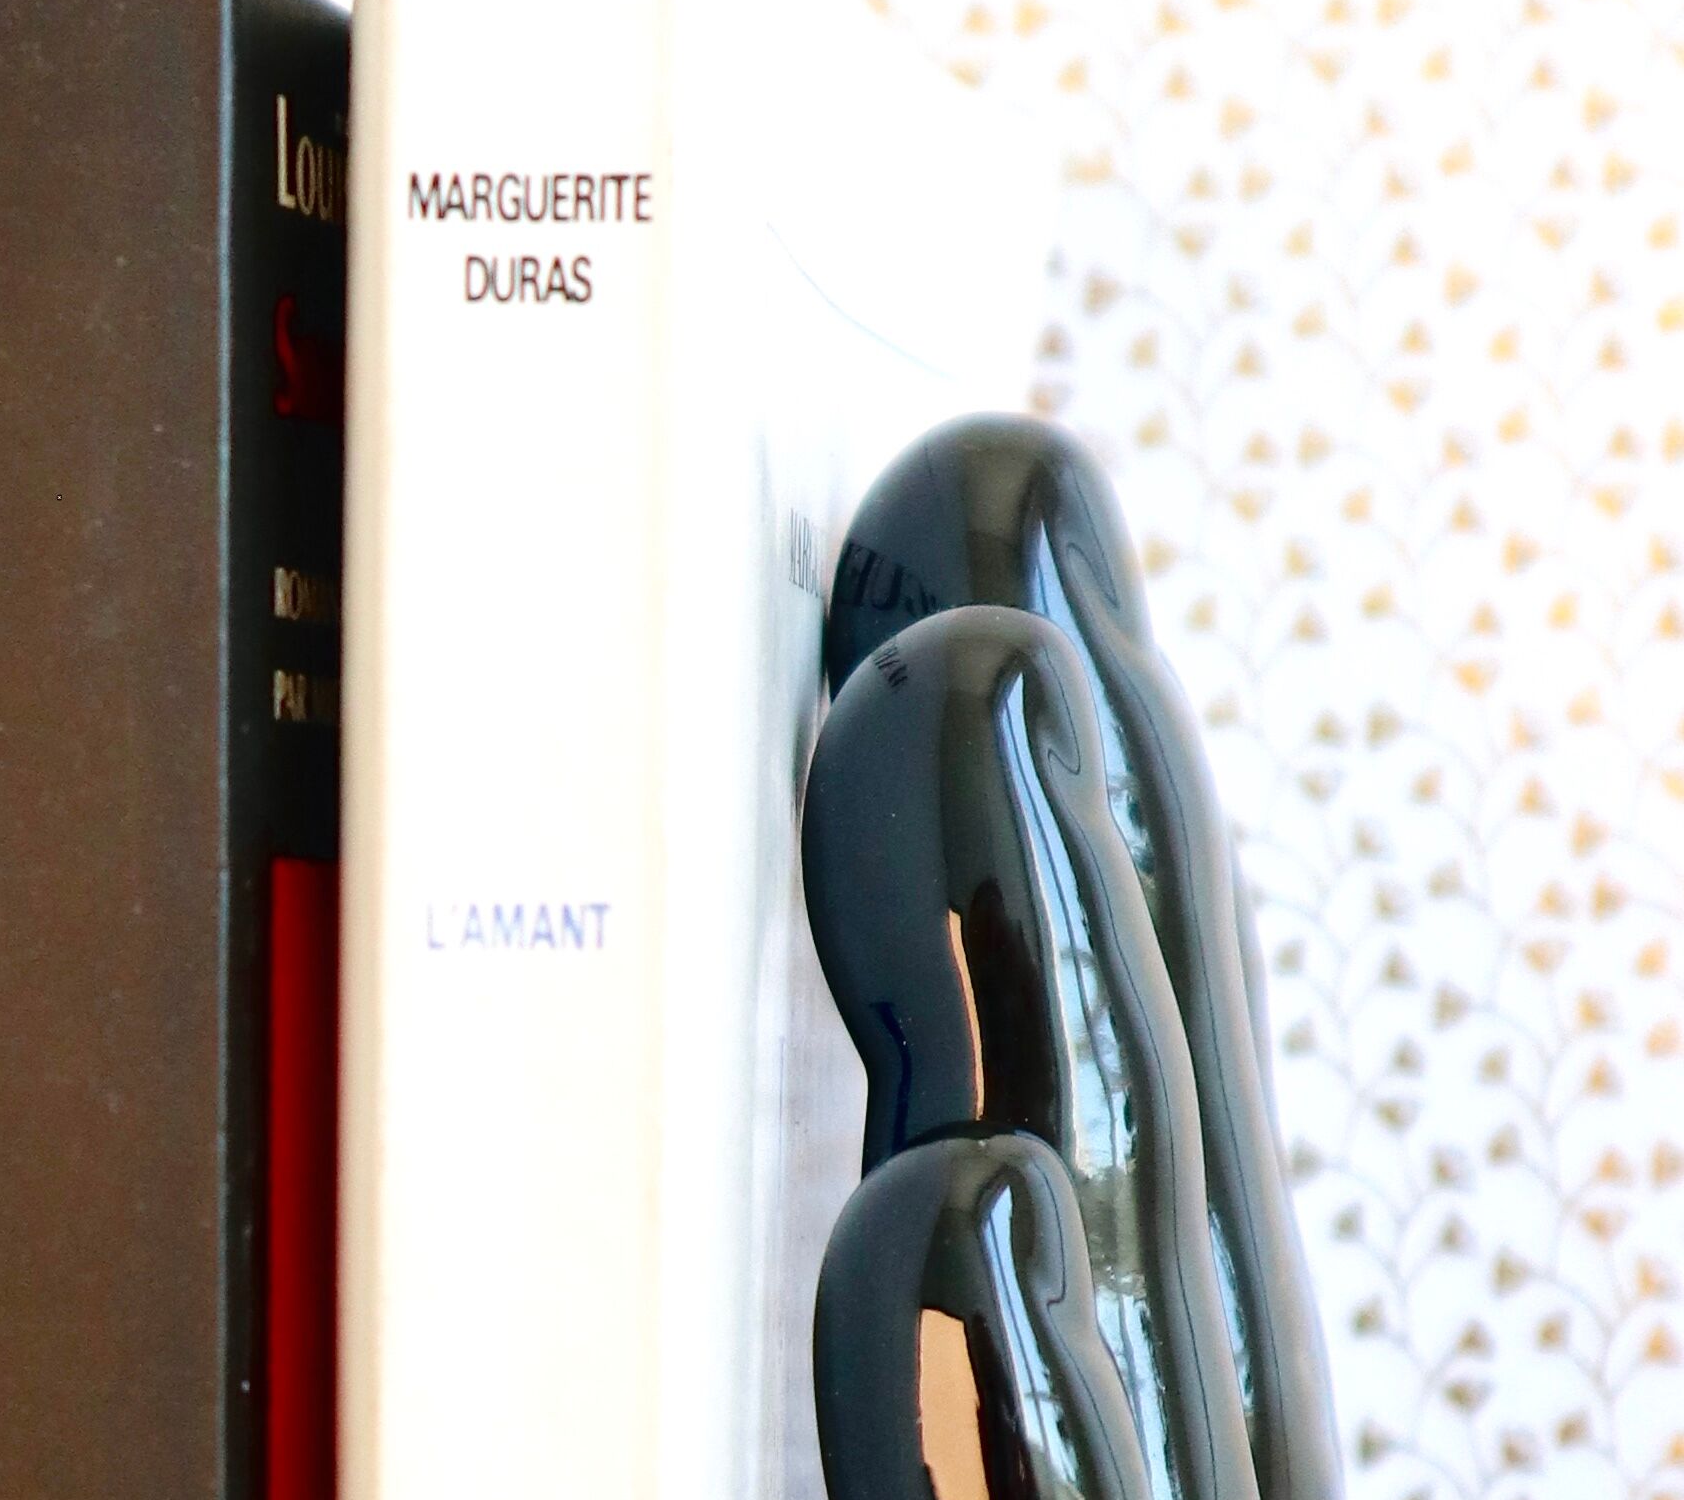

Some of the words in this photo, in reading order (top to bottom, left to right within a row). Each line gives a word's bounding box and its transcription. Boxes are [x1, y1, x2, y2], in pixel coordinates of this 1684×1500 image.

[408, 172, 652, 223] MARGUERITE
[464, 255, 593, 304] DURAS
[426, 902, 611, 950] L'AMANT
